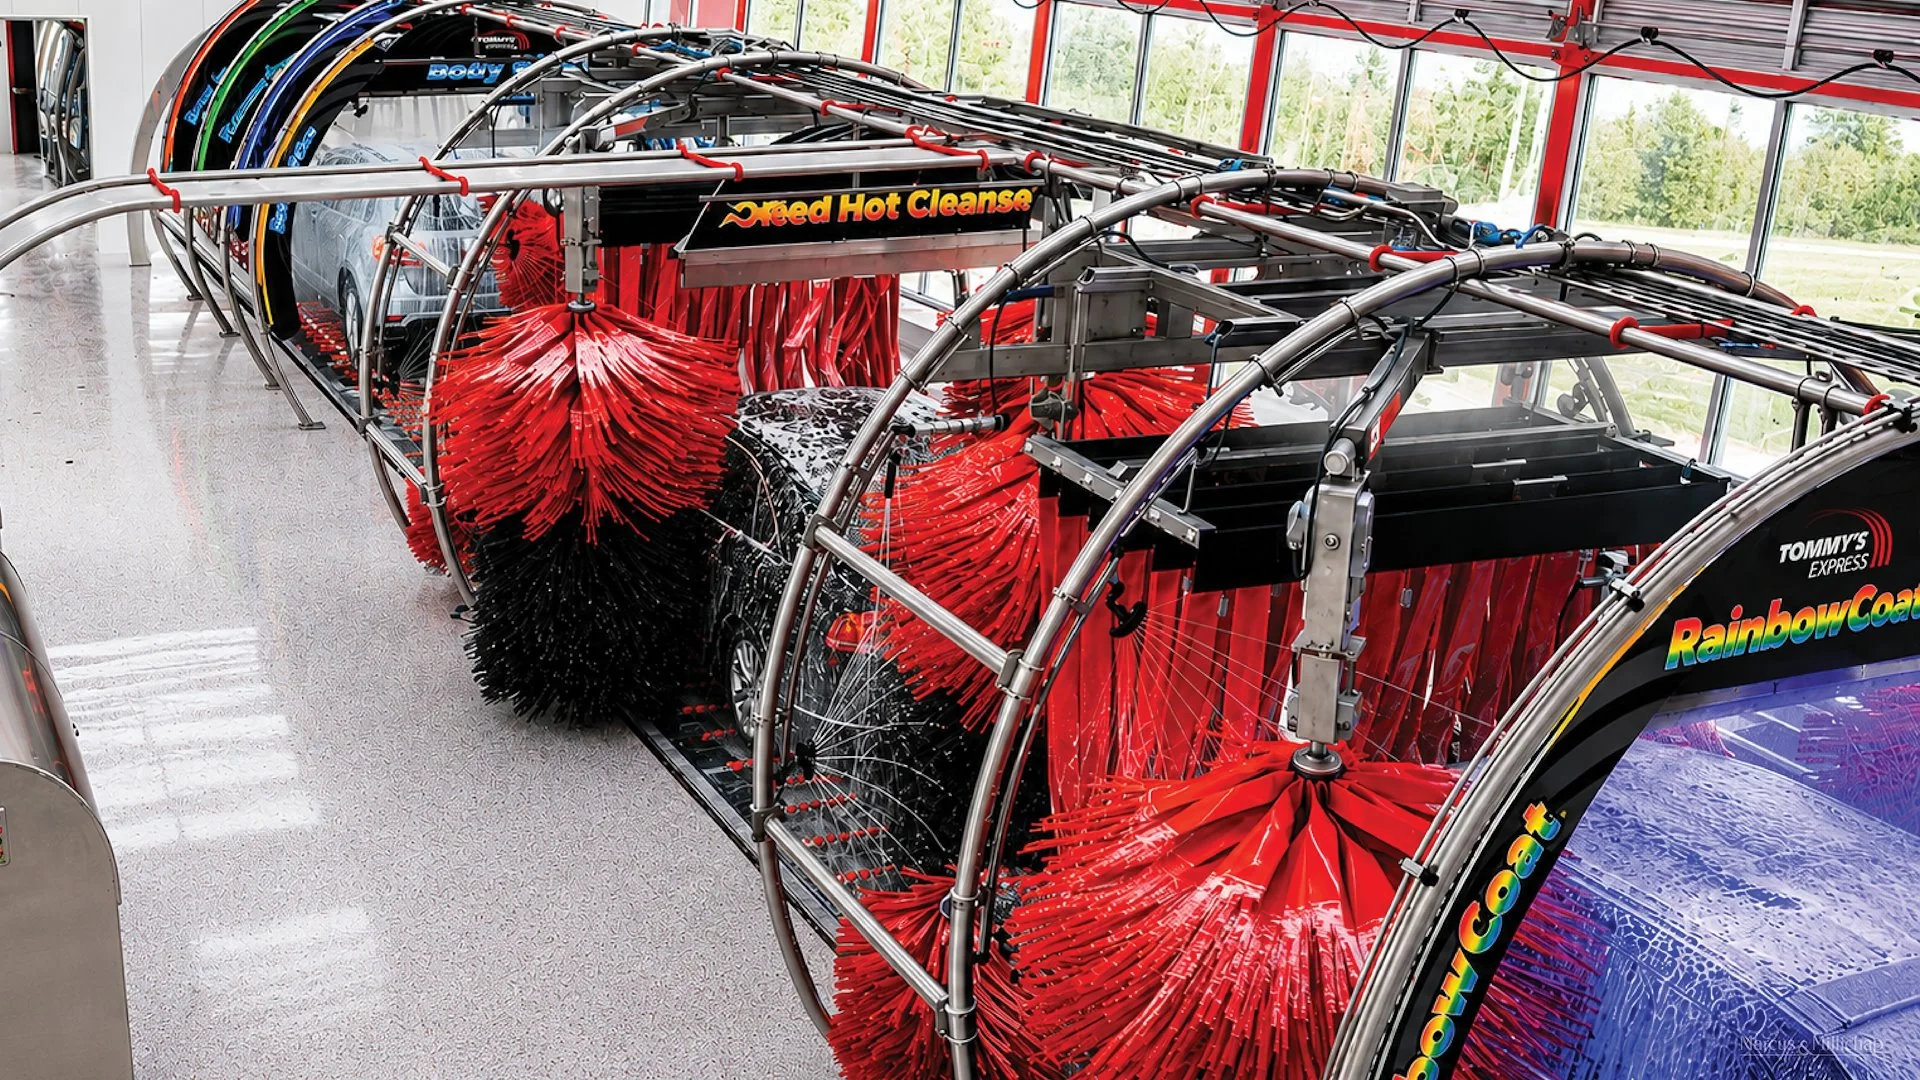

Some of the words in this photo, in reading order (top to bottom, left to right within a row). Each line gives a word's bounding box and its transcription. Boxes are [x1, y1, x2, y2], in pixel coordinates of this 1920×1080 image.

[427, 62, 505, 84] Body
[838, 193, 901, 222] Hot
[906, 188, 1034, 219] Cleanse
[1779, 531, 1869, 564] TOMMY'S
[1808, 553, 1869, 579] EXPRESS
